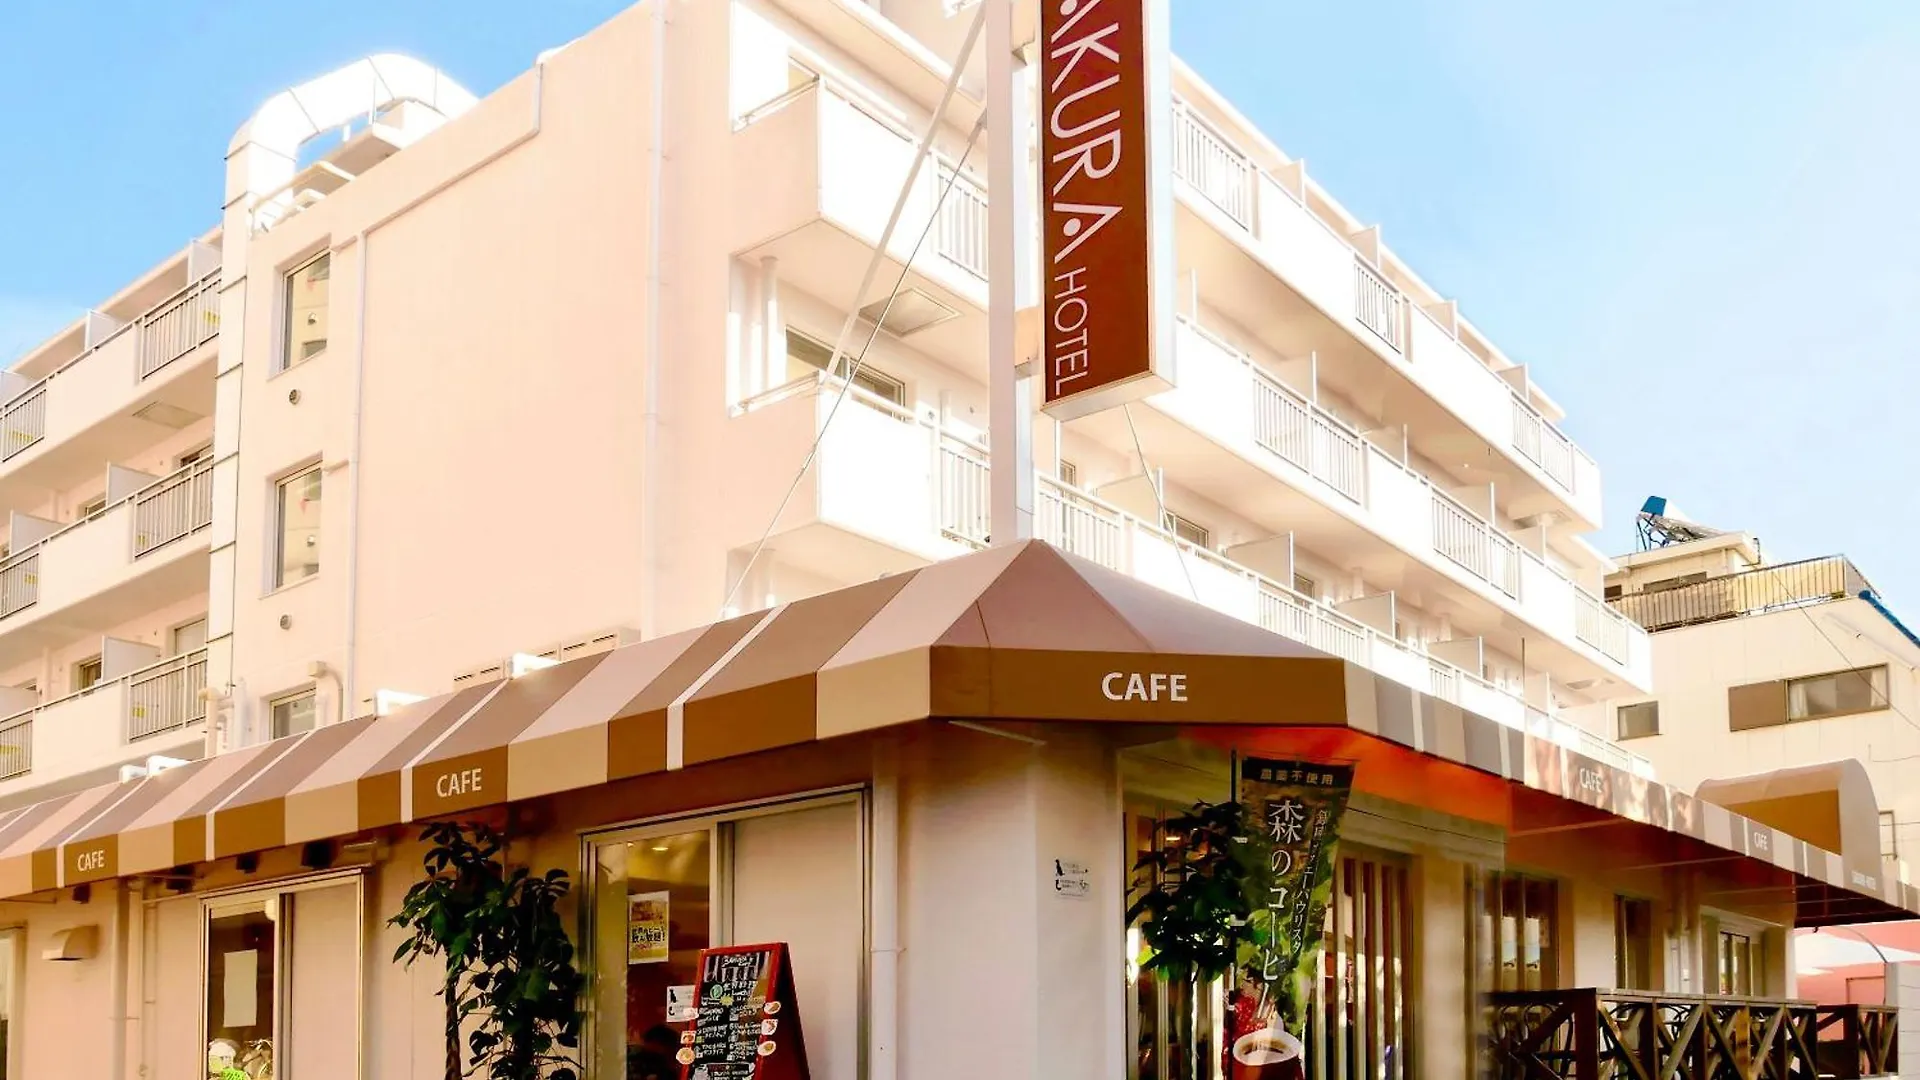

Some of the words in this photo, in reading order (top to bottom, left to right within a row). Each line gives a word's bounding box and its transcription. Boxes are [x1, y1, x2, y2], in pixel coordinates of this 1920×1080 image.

[1054, 267, 1088, 396] HOTEL
[1101, 672, 1188, 702] CAFE
[436, 768, 482, 797] CAFE
[1579, 768, 1602, 793] CAFE
[77, 849, 105, 872] CAFE
[1255, 800, 1304, 1020] 森のコーヒー
